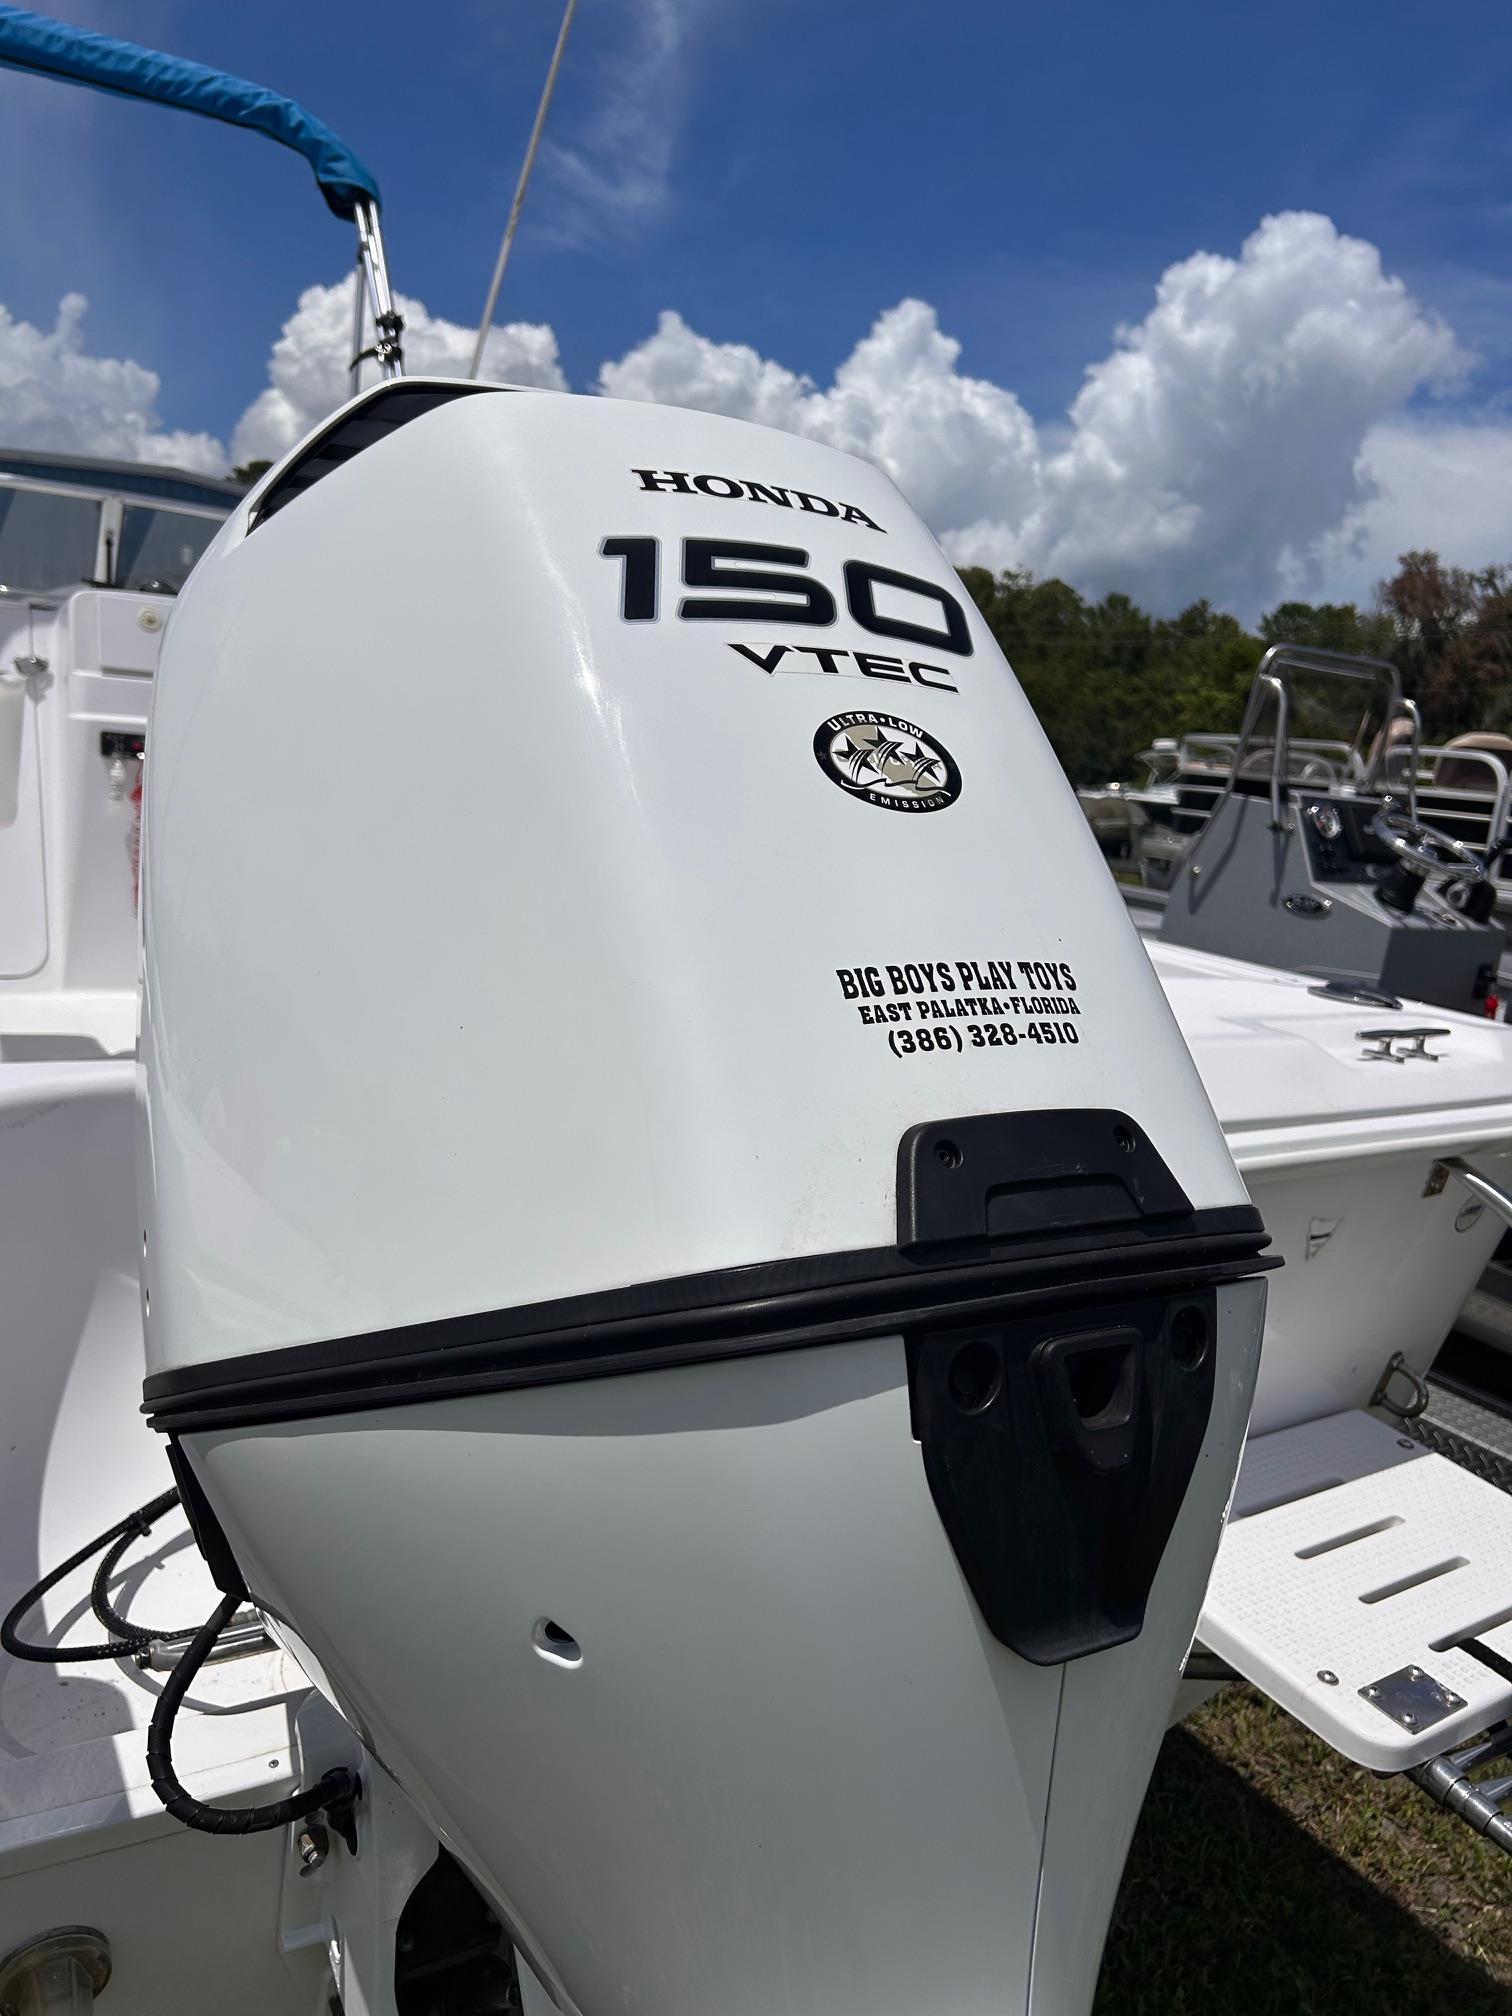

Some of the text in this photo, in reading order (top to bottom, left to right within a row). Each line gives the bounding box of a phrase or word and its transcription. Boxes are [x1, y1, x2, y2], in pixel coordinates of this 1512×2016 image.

[631, 469, 887, 534] HONDA
[598, 536, 973, 657] 150
[726, 642, 960, 694] VTEC
[869, 792, 945, 809] EMISSION
[836, 961, 1077, 1000] BIG BOYS PLAY TOYS
[858, 1002, 912, 1025] EAST
[888, 1022, 1080, 1059] (386) 328-4510
